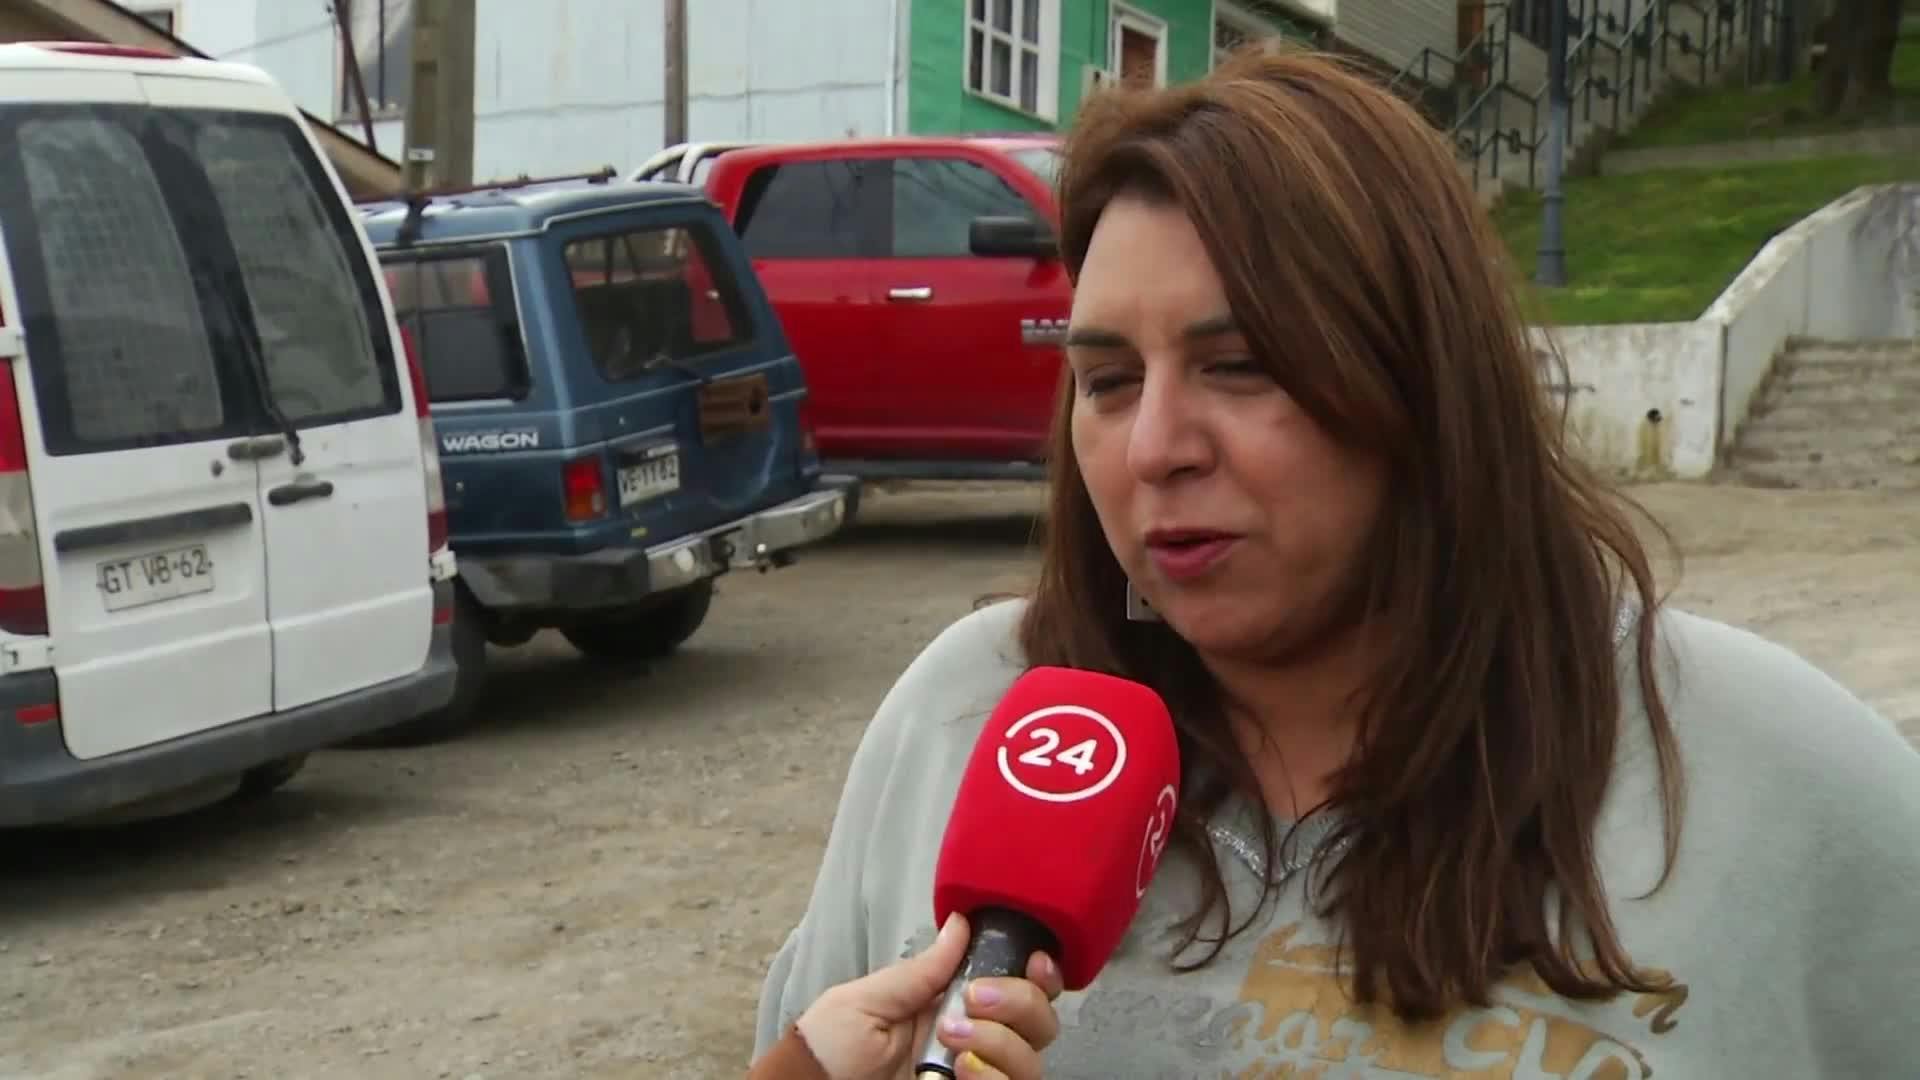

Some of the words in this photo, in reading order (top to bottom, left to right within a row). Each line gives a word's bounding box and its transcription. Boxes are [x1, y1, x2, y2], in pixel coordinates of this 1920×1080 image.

[442, 432, 538, 451] WAGON
[103, 561, 132, 593] GT
[1019, 728, 1097, 775] 24
